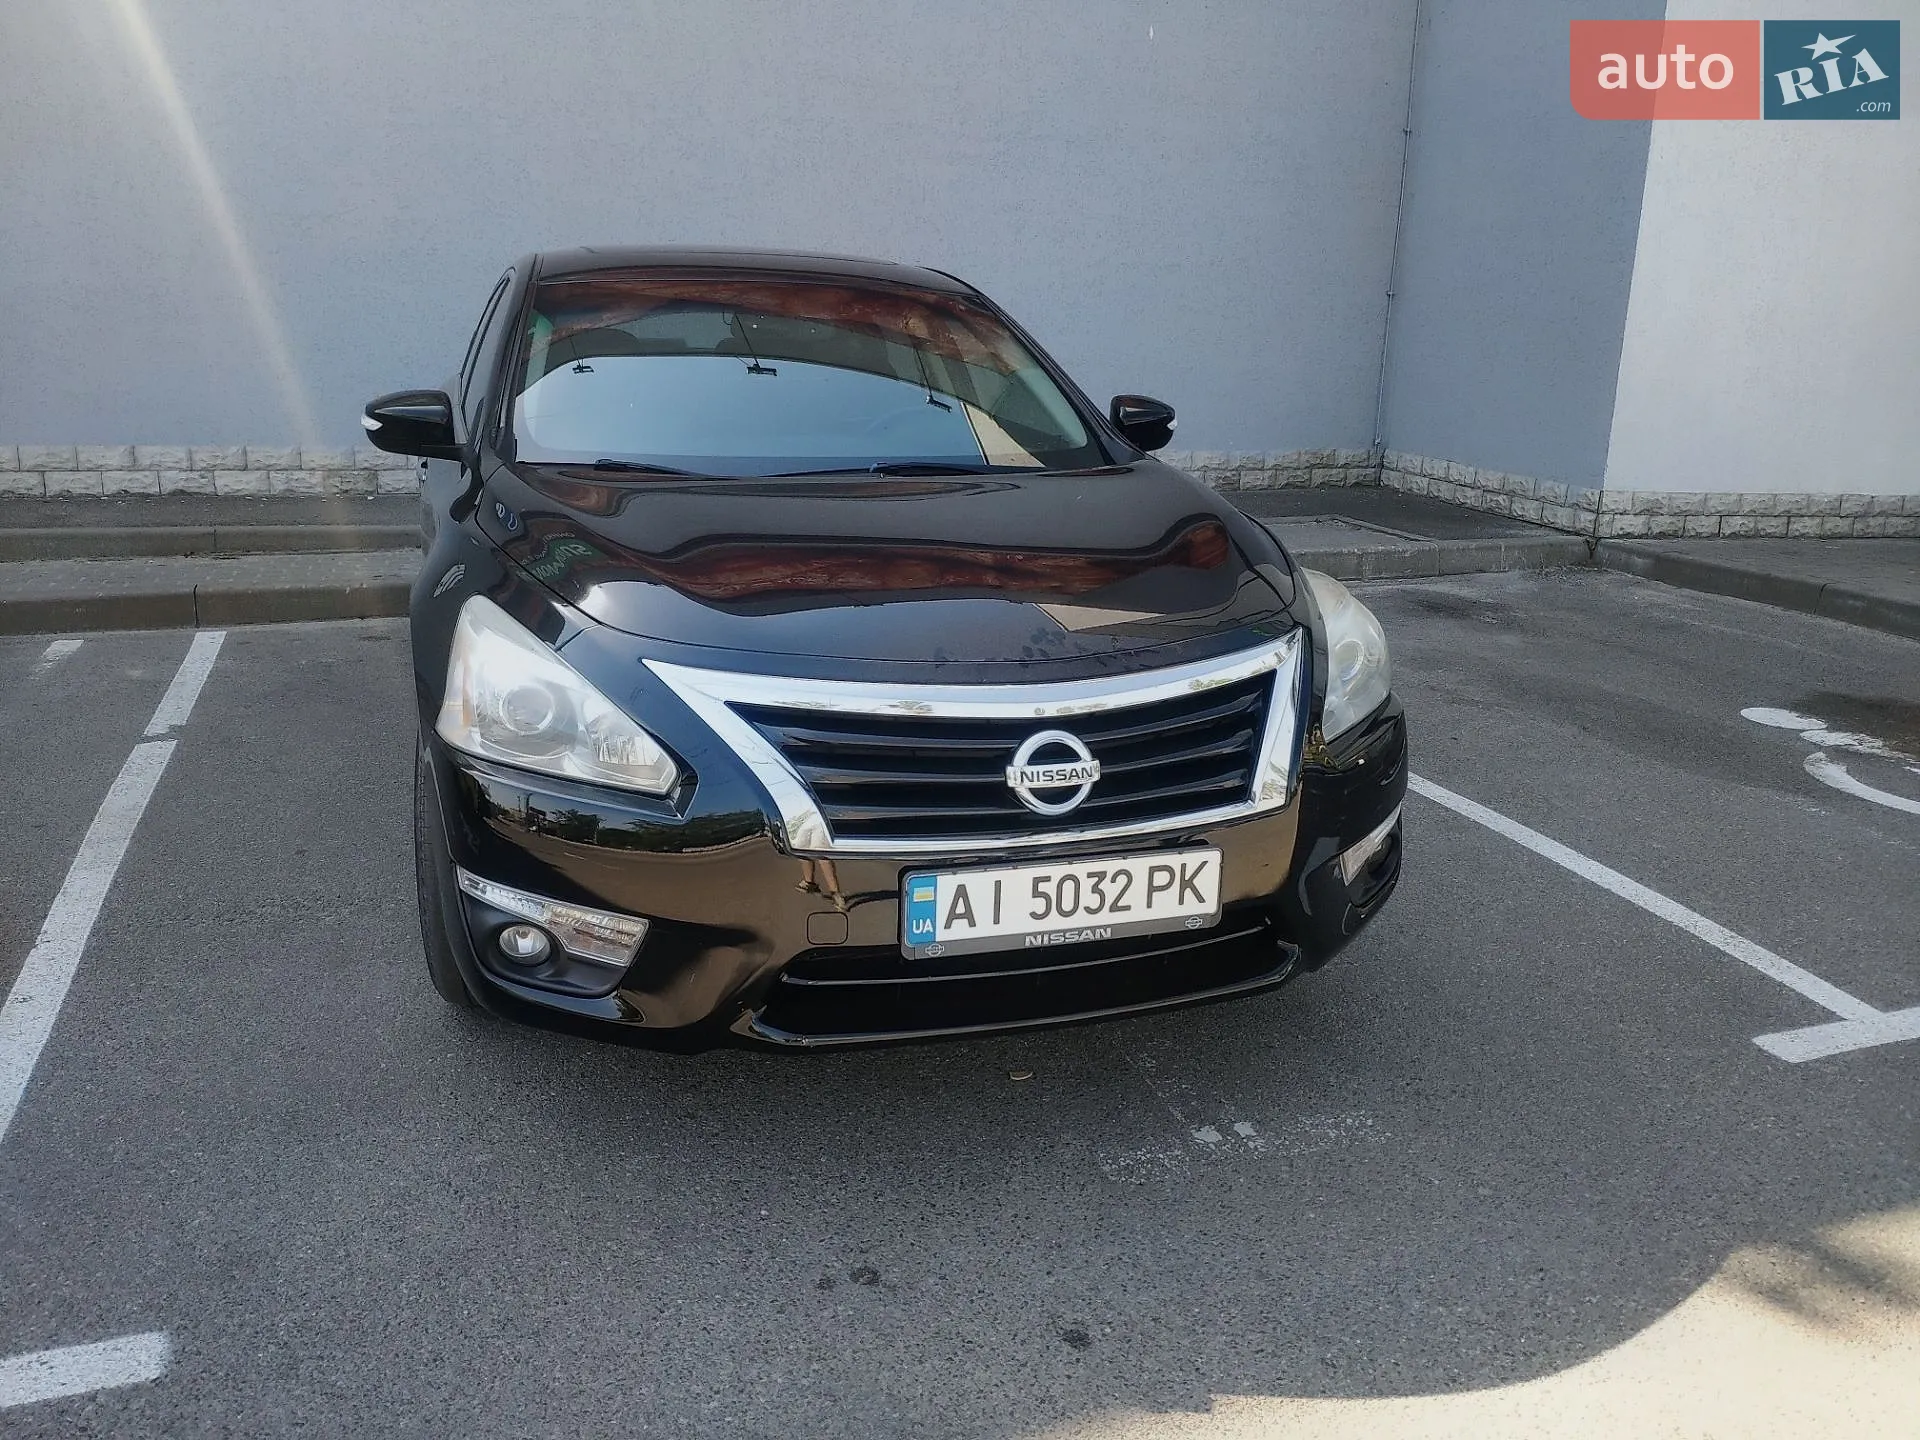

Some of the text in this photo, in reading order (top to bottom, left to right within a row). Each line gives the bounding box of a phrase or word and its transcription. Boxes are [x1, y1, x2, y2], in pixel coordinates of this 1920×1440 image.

[1020, 765, 1093, 784] NISSAN
[944, 861, 1209, 929] AI 5032 PK
[912, 918, 934, 934] UA
[1024, 927, 1112, 946] NISSAN
